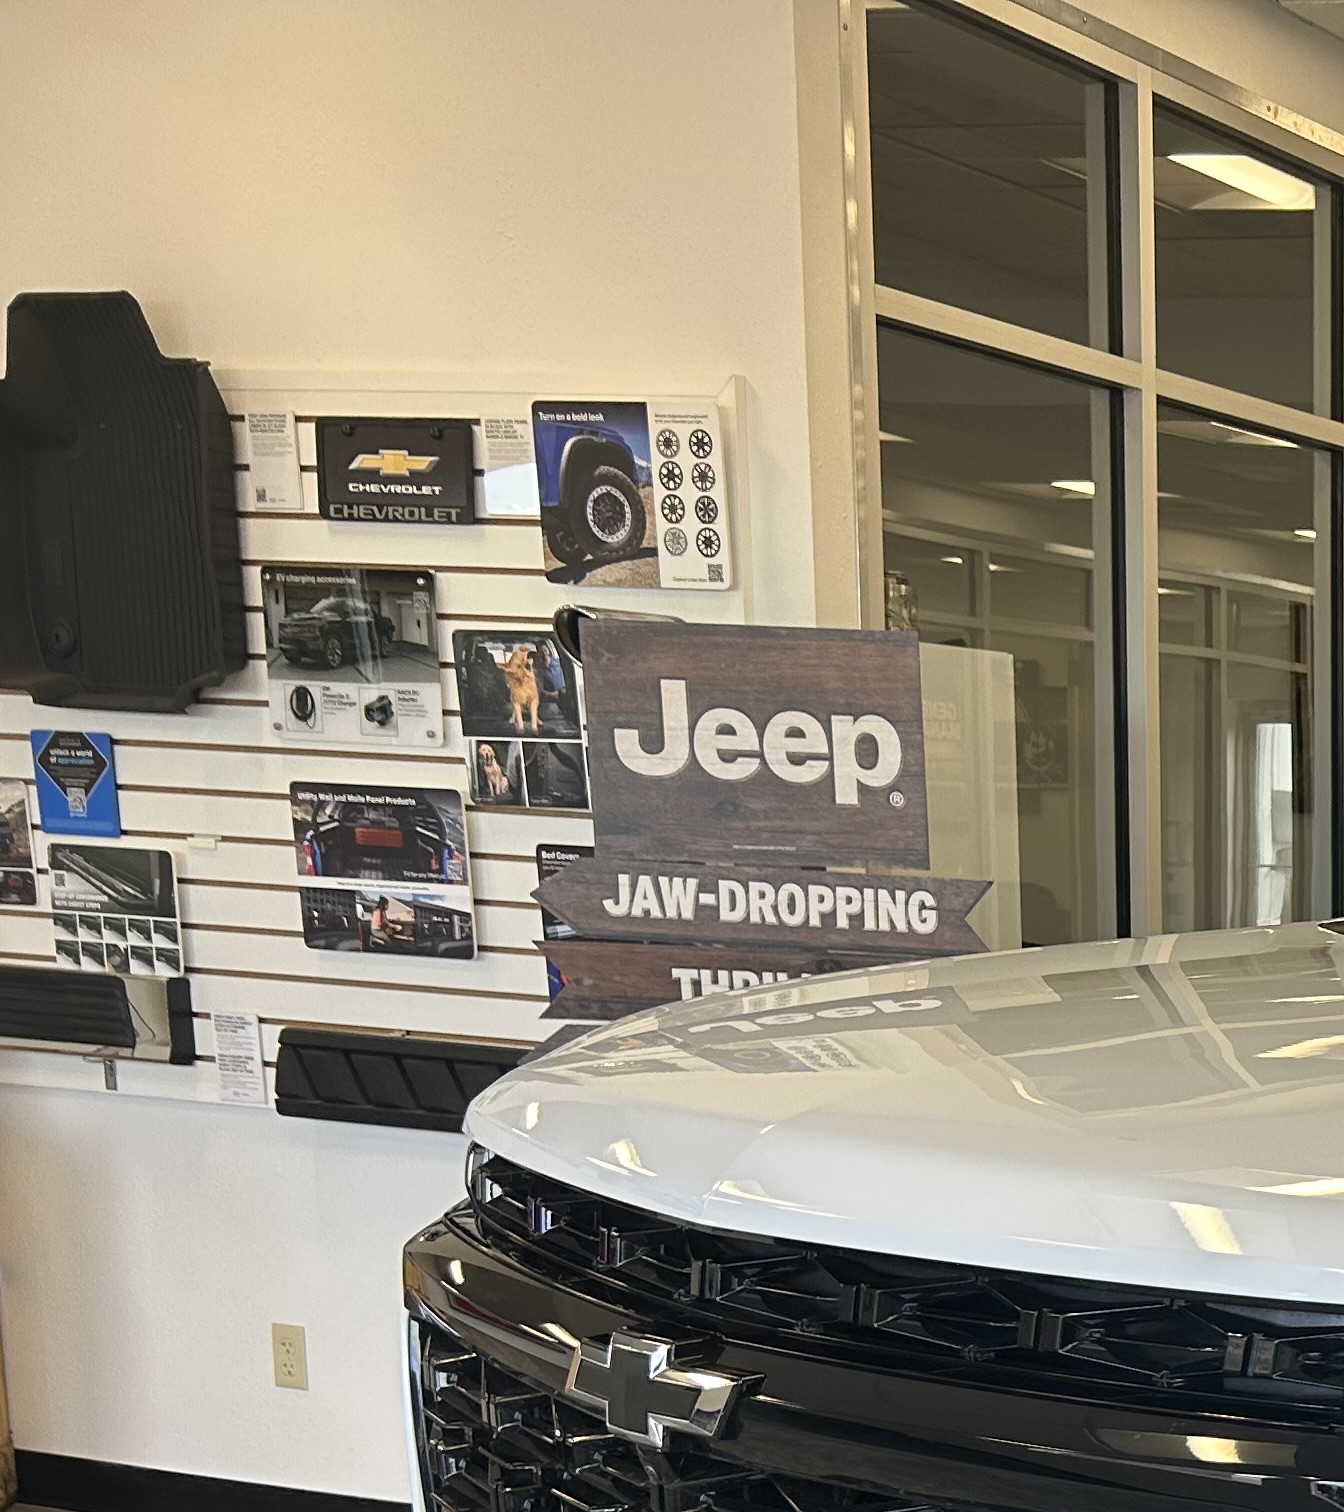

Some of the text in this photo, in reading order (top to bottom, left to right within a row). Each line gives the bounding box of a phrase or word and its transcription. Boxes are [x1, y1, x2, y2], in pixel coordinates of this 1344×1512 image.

[348, 482, 443, 495] CHEVROLET
[329, 503, 461, 523] CHEVROLET
[613, 678, 902, 806] Jeep
[602, 872, 938, 935] JAW-DROPPING
